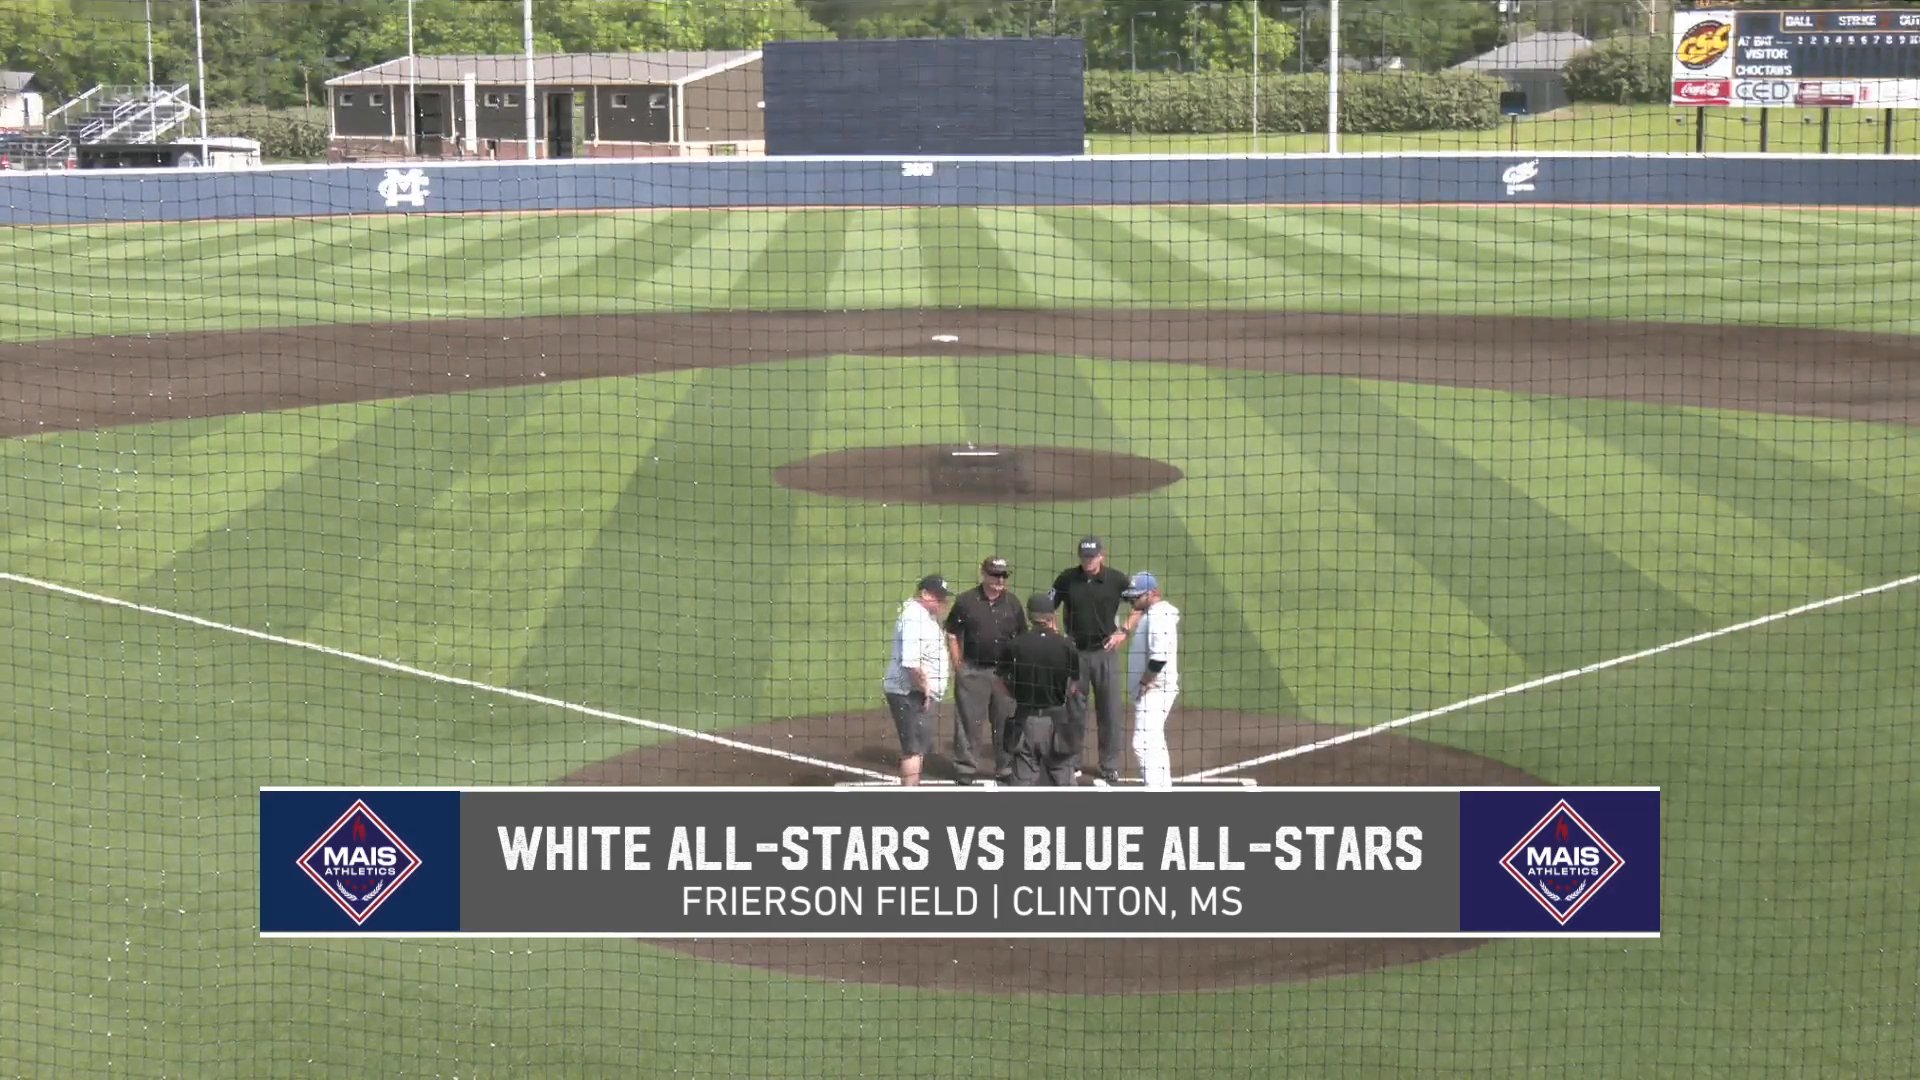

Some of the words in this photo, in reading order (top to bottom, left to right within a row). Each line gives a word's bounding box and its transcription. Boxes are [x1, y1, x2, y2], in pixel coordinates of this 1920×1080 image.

[1785, 16, 1813, 27] BALL
[1838, 15, 1877, 26] STRIKE
[1737, 35, 1751, 47] AT
[1753, 35, 1774, 47] BAT
[1745, 48, 1789, 60] VISITOR
[1736, 65, 1793, 76] CHOCTAWS
[1736, 81, 1789, 100] CED
